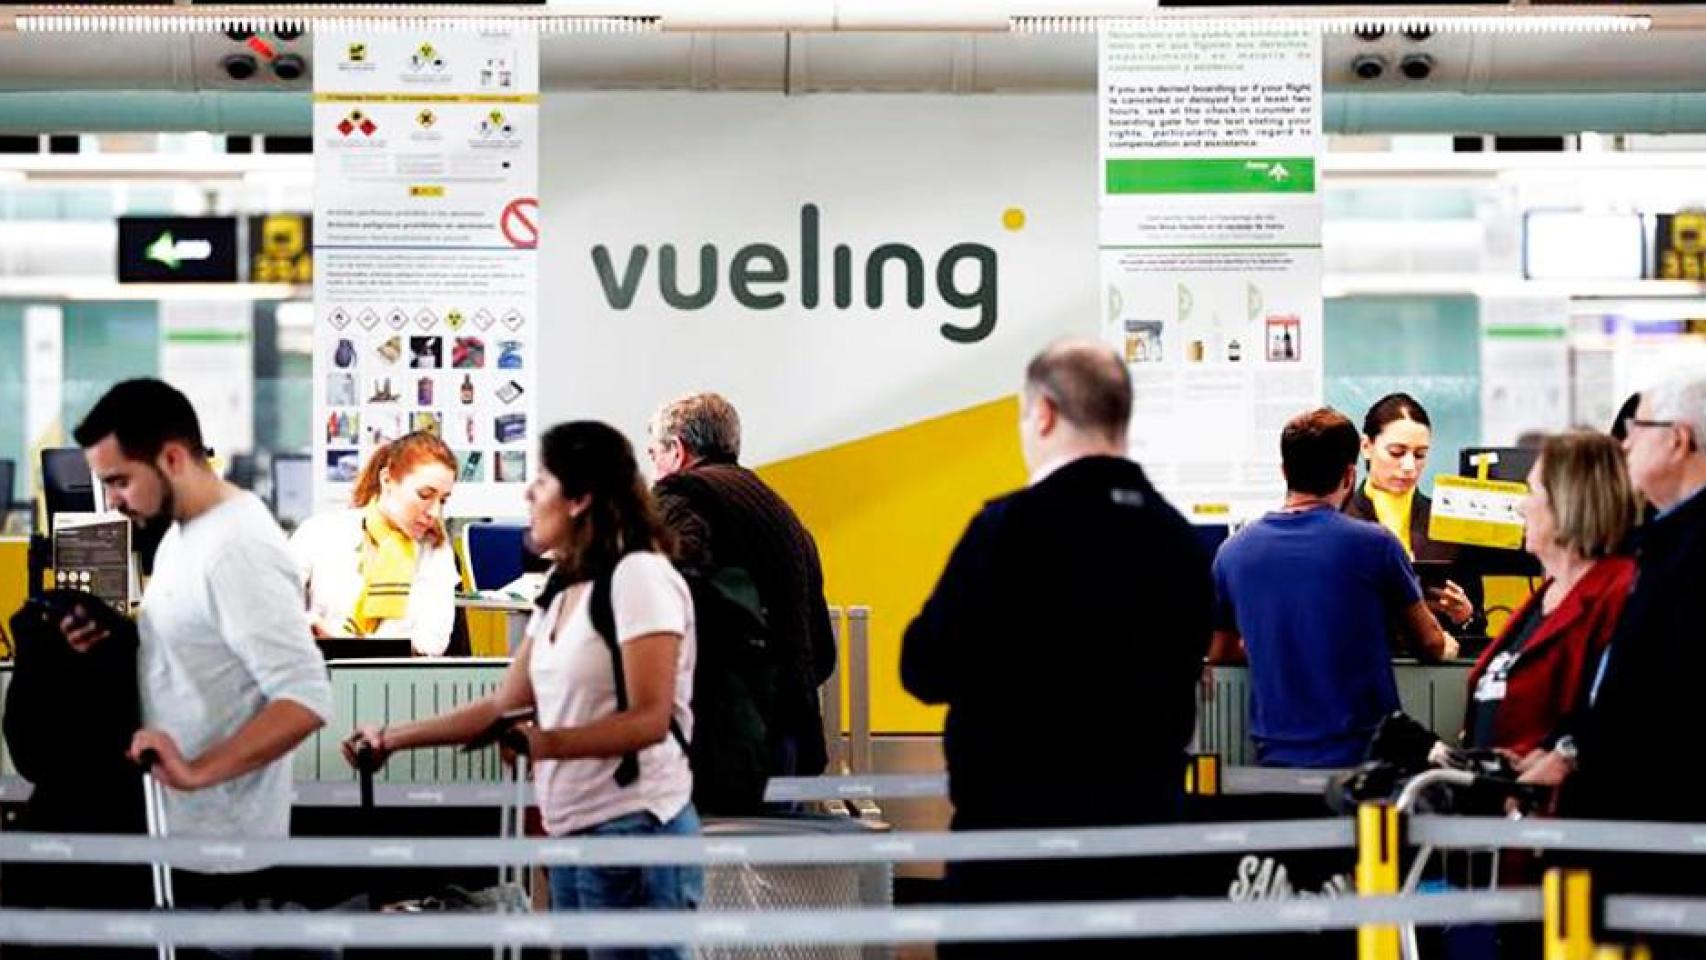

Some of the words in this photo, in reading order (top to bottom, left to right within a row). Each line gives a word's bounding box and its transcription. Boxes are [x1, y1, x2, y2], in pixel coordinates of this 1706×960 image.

[1118, 86, 1135, 95] you
[1157, 84, 1189, 93] denied
[1193, 83, 1235, 95] boarding
[1262, 86, 1282, 95] your
[1286, 83, 1311, 95] flight
[1109, 96, 1117, 104] is
[1122, 95, 1170, 104] cancelled
[1189, 95, 1228, 105] delayed
[1233, 95, 1246, 103] for
[1264, 95, 1289, 103] least
[1293, 95, 1311, 103] two
[1148, 106, 1164, 114] ask
[1184, 106, 1200, 114] the
[1109, 117, 1155, 127] boarding
[1160, 118, 1180, 127] gate
[1186, 117, 1199, 125] for
[1205, 117, 1219, 125] the
[1288, 119, 1311, 127] your
[1153, 128, 1217, 138] particularly
[1225, 128, 1248, 136] with
[1255, 128, 1293, 138] regard
[1109, 140, 1180, 149] compensation
[590, 203, 1025, 343] vueling
